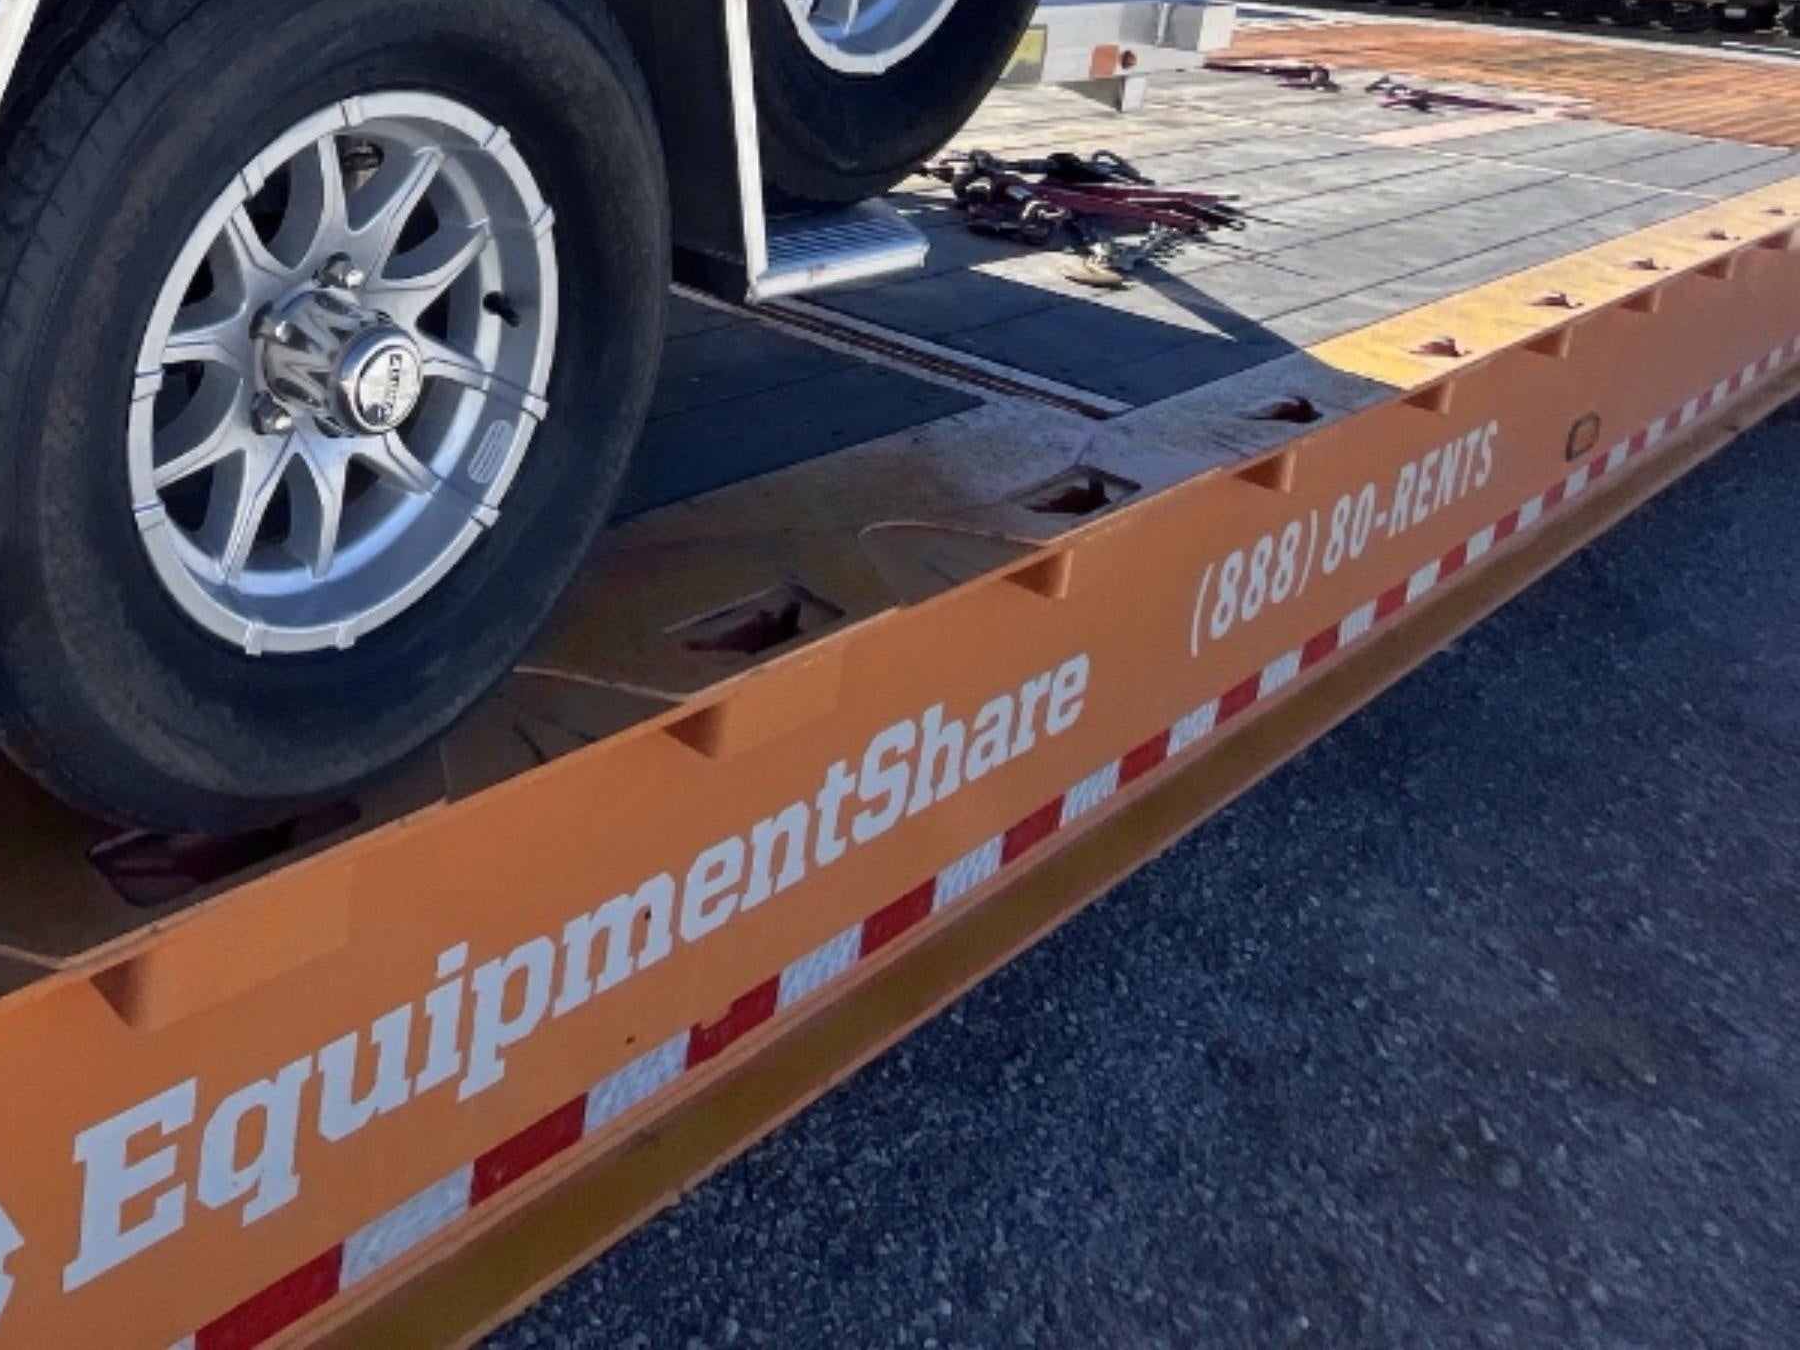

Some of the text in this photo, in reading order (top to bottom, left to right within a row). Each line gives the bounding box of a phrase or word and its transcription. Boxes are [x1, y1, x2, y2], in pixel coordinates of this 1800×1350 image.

[1190, 418, 1499, 658] (888) 80-RENTS
[61, 653, 1090, 1295] EquipmentShare
